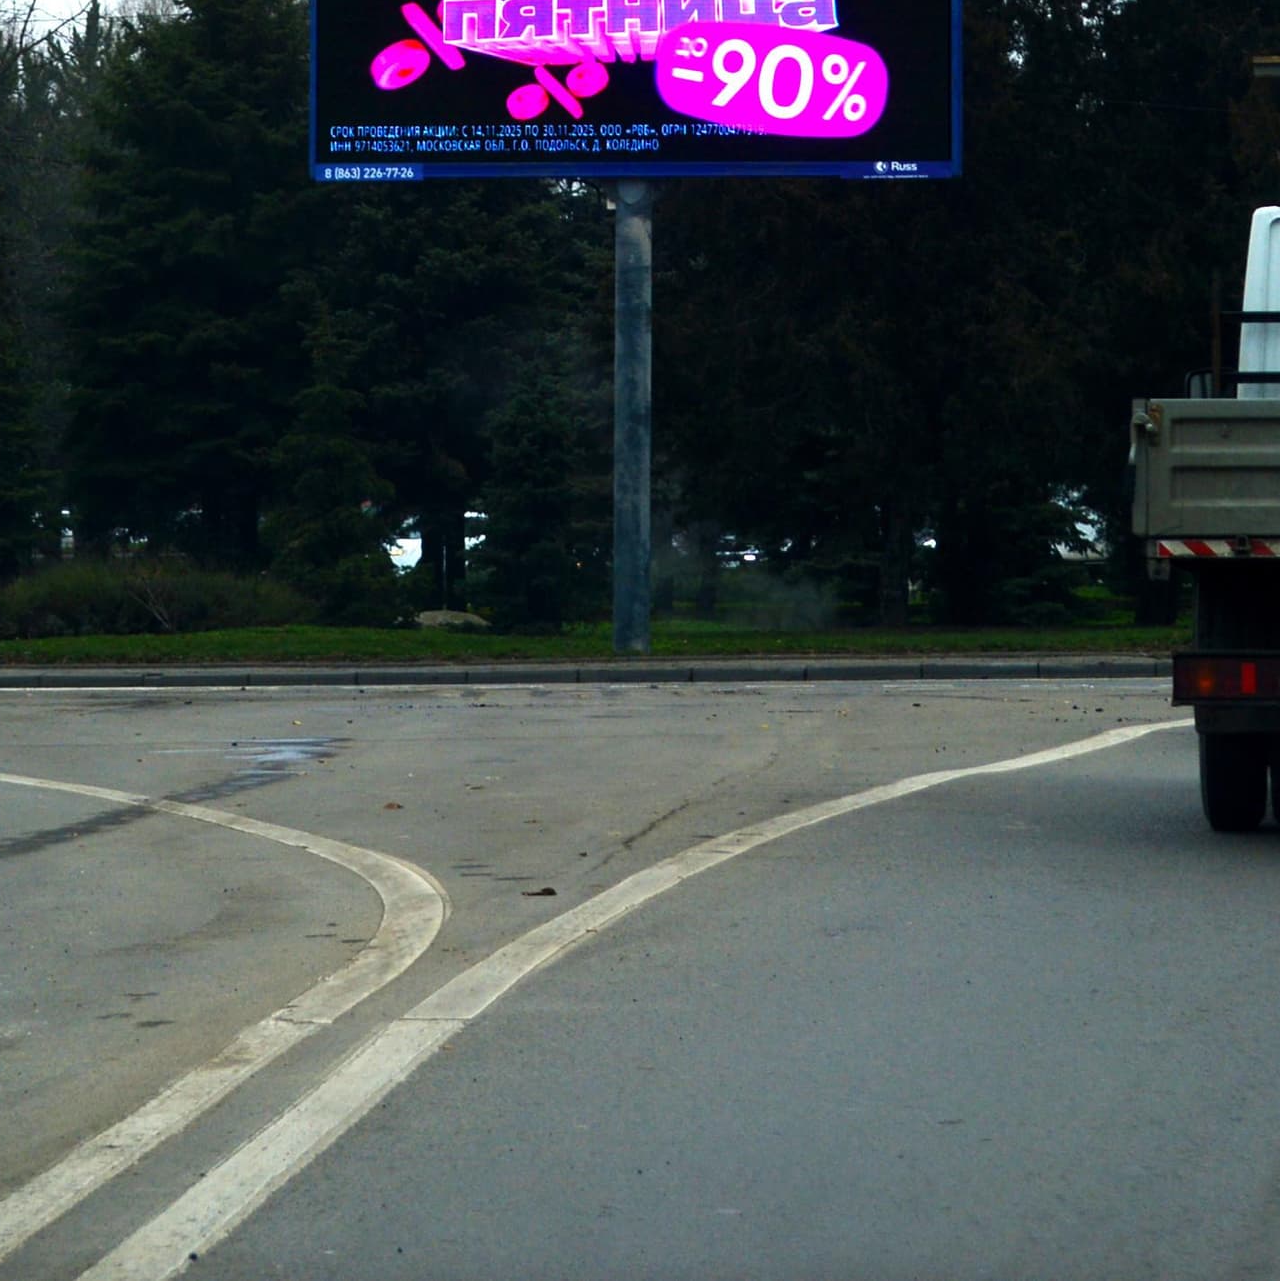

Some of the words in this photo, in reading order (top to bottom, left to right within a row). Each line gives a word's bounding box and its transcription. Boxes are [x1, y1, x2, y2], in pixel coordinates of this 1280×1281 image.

[329, 126, 355, 138] СРОК
[357, 126, 420, 138] ПРОВЕДЕНИЯ
[524, 125, 539, 137] ПО
[599, 125, 622, 137] ООО
[330, 140, 352, 152] ИНН
[416, 140, 481, 152] МОСКОВСКАЯ
[606, 139, 660, 151] КОЛЕДИНО
[890, 161, 918, 172] Russ
[324, 167, 332, 179] 8
[334, 167, 362, 181] (863)
[363, 167, 415, 179] 226-77-26
